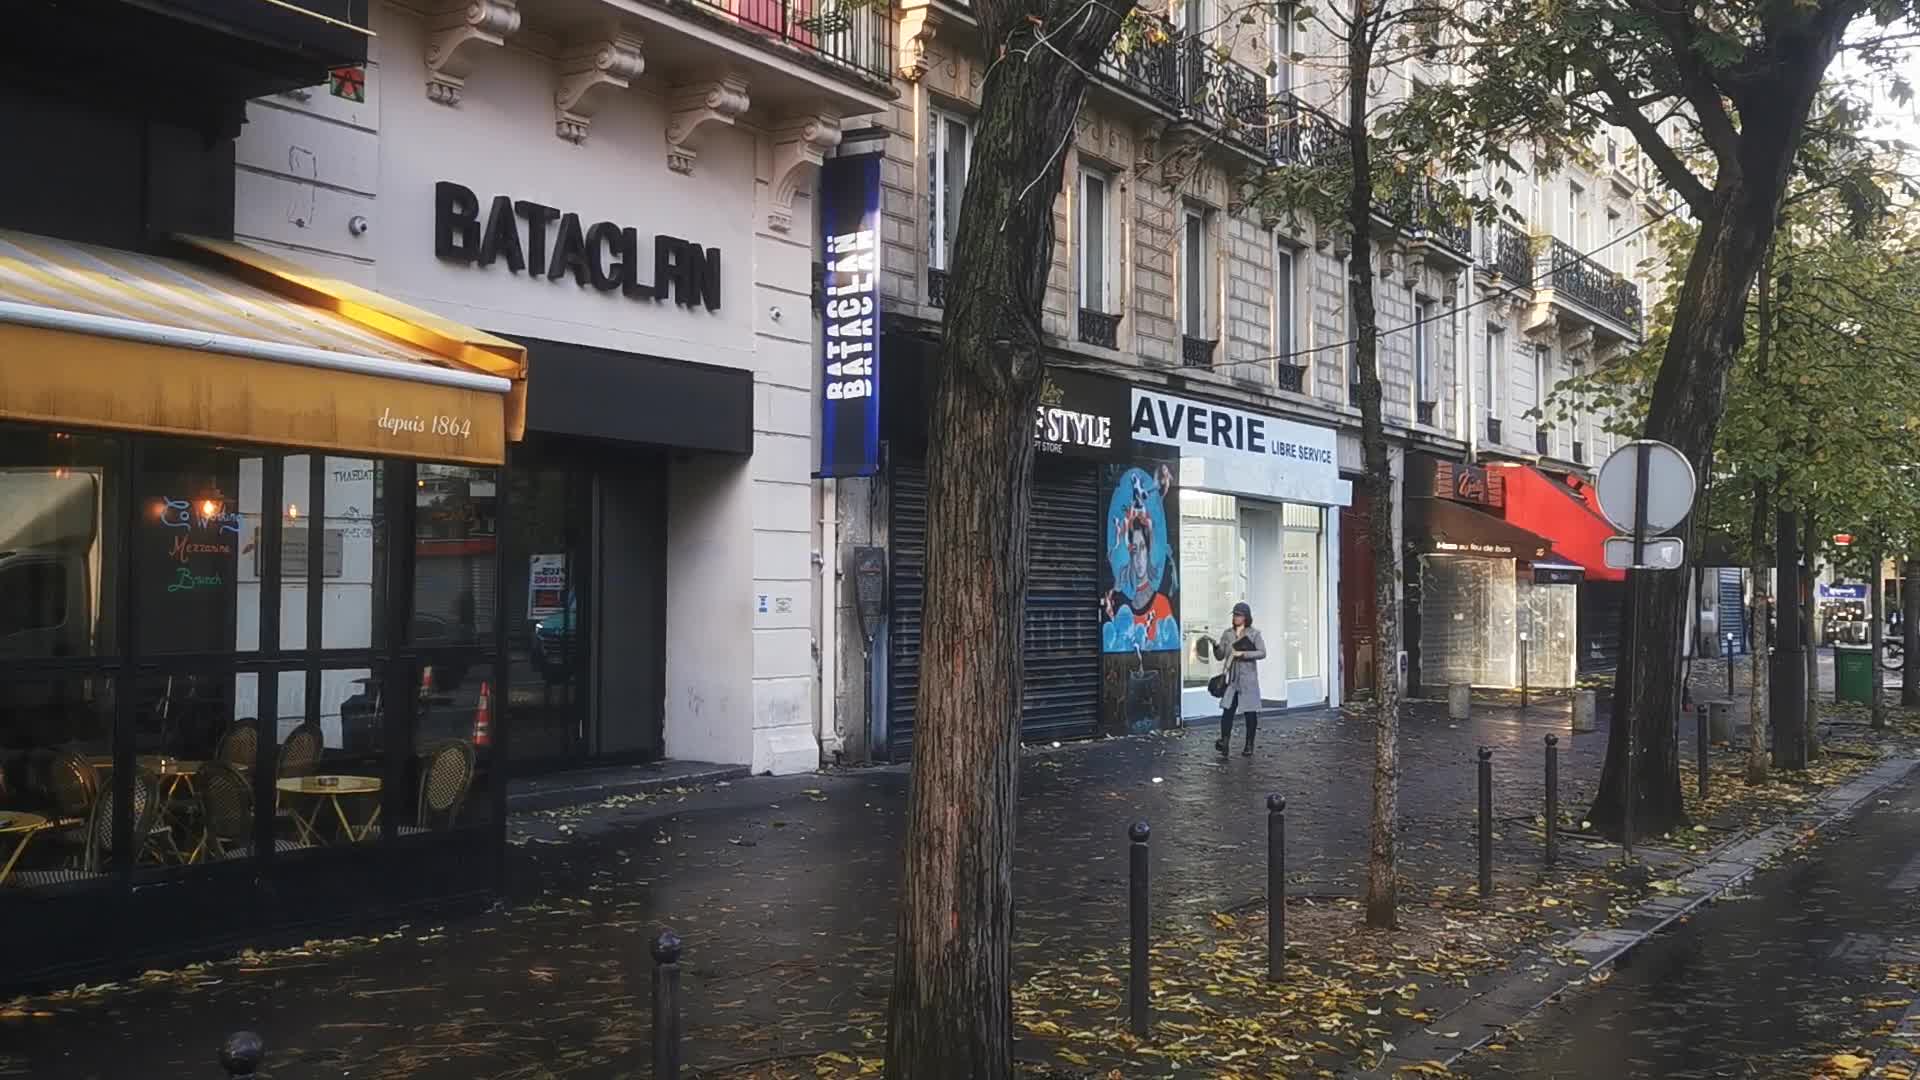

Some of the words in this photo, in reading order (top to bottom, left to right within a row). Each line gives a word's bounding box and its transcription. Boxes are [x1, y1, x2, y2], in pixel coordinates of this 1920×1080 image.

[435, 181, 720, 312] BATACLAN
[378, 407, 424, 436] depuis
[432, 415, 471, 439] 1864
[1132, 396, 1266, 453] AVERIE
[1042, 441, 1063, 454] STORE
[1271, 440, 1297, 458] LIBRE
[1299, 445, 1332, 464] SERVICE
[168, 567, 222, 592] Brunch
